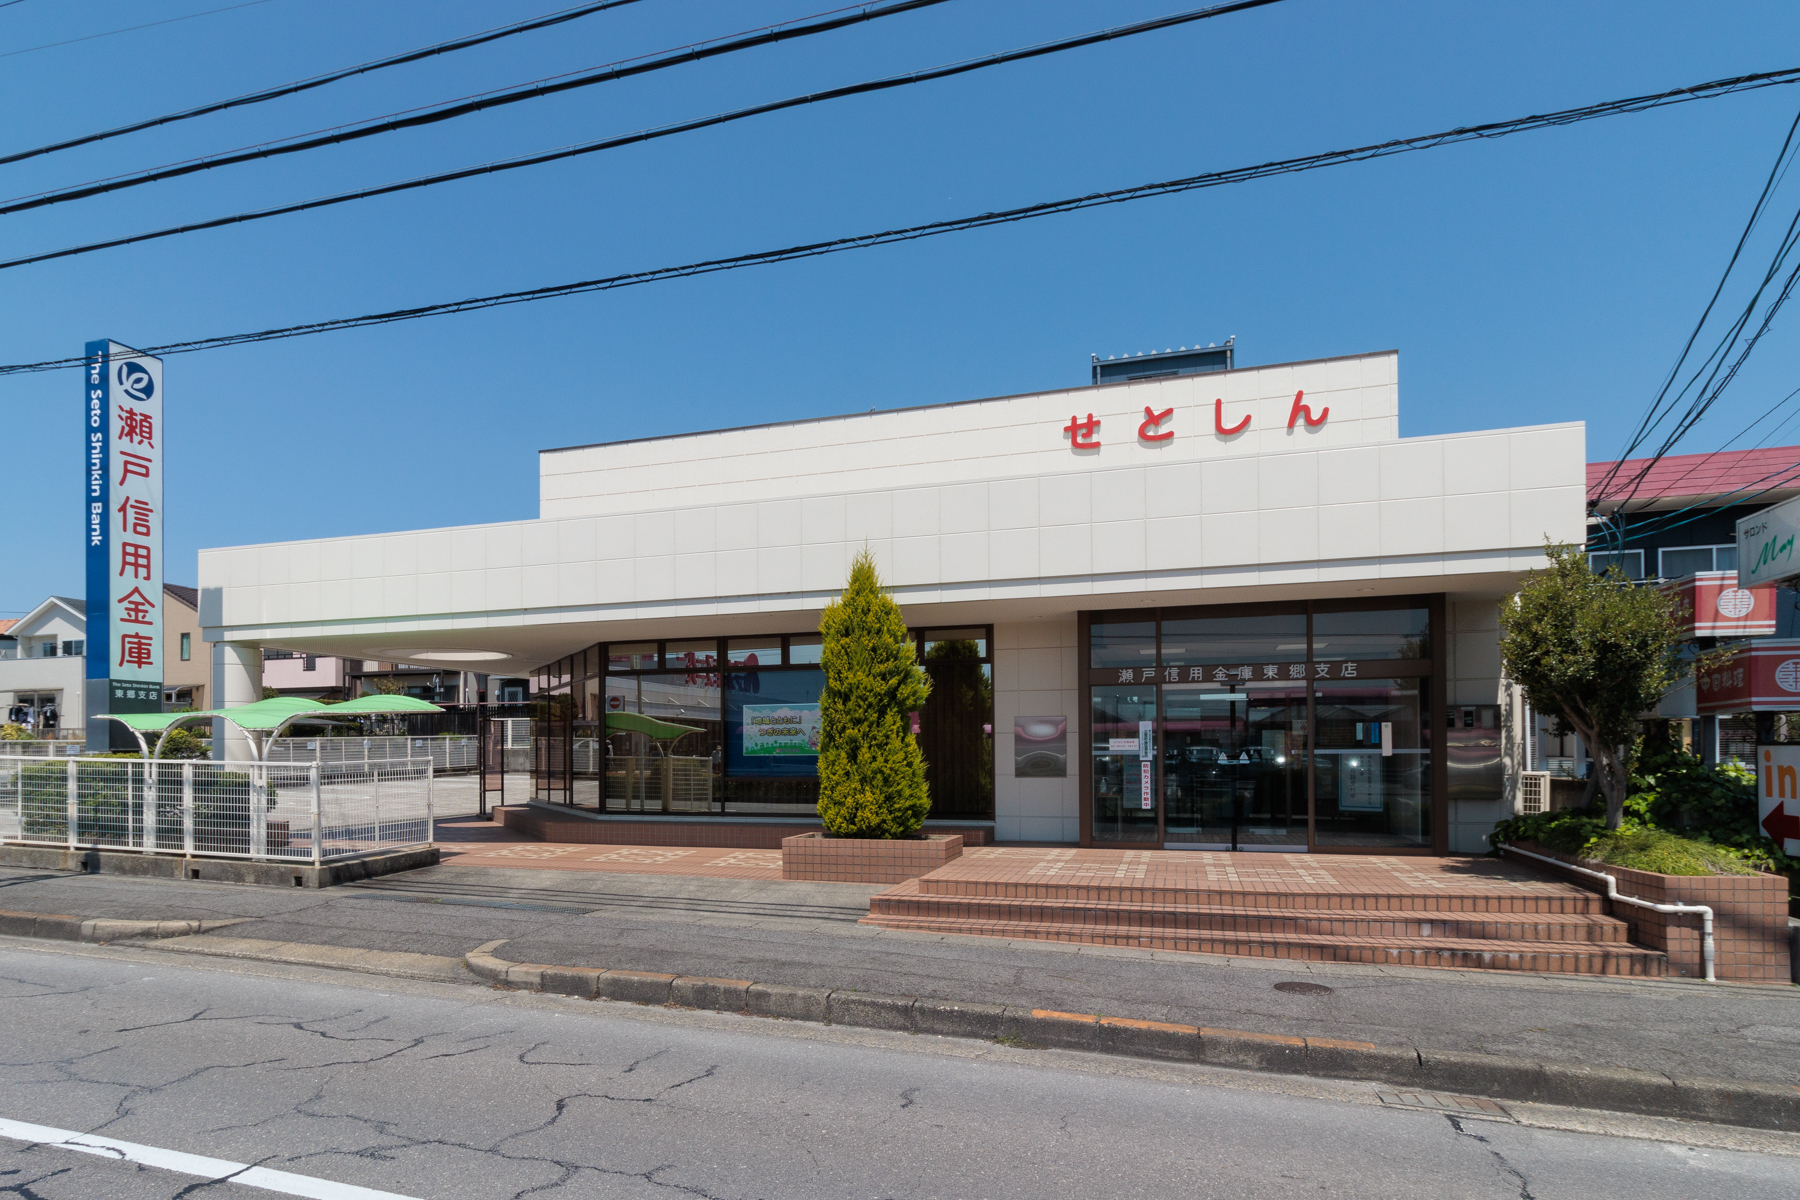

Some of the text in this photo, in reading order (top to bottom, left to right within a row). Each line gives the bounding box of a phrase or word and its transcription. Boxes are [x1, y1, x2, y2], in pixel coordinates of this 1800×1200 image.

[90, 389, 103, 428] Seto
[1063, 389, 1330, 449] せとしん
[90, 432, 103, 497] Shinkin
[90, 502, 103, 547] Bank
[116, 404, 156, 669] 瀬戸信用金庫
[1743, 521, 1768, 540] サロンド
[1751, 533, 1795, 575] May
[1118, 661, 1358, 684] 瀬戸信用金庫東郷支店
[114, 689, 158, 700] 東郷支店
[758, 726, 806, 736] つぎの未来へ
[1763, 749, 1798, 800] in
